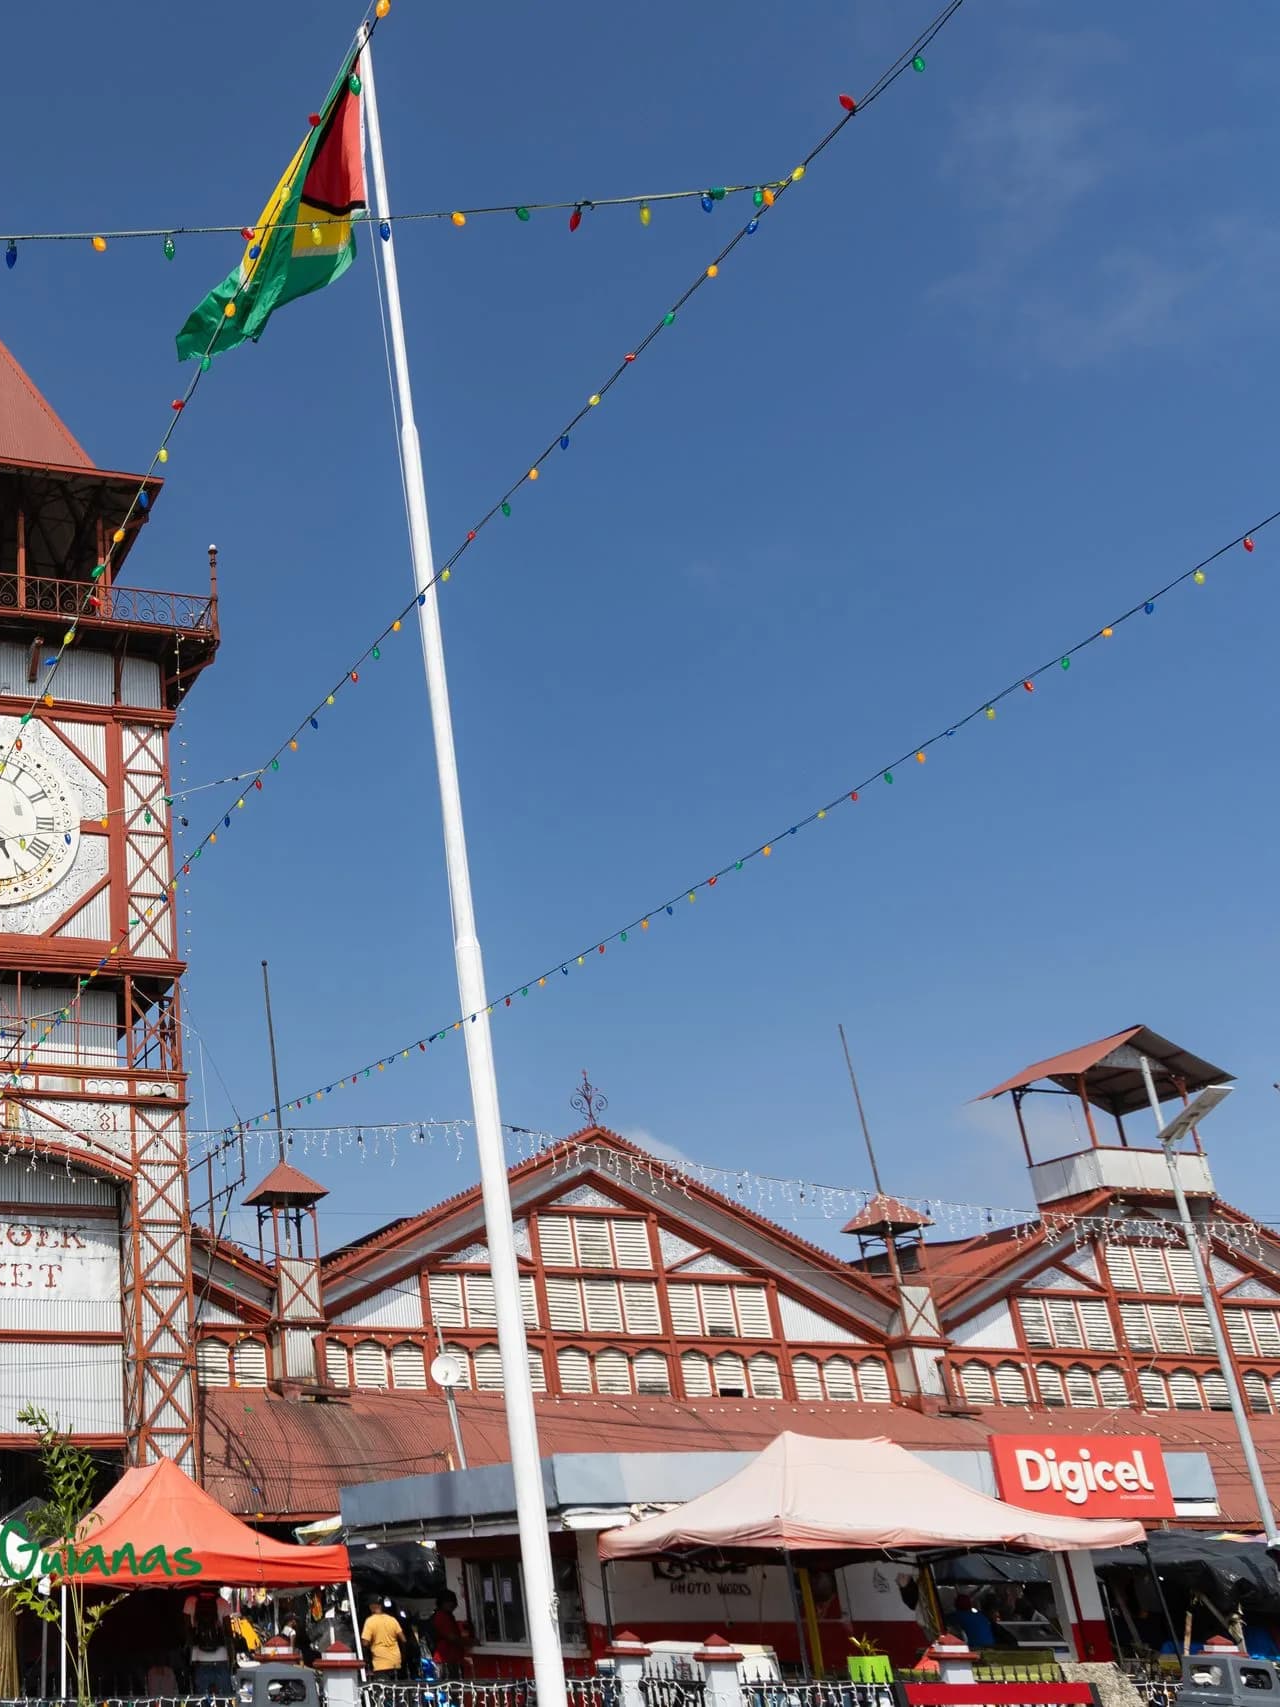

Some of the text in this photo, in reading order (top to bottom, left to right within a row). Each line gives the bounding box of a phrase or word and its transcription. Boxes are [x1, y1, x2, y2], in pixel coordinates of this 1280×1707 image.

[99, 1112, 117, 1132] 81
[1014, 1447, 1155, 1505] Digicel
[670, 1582, 712, 1595] PHOTO
